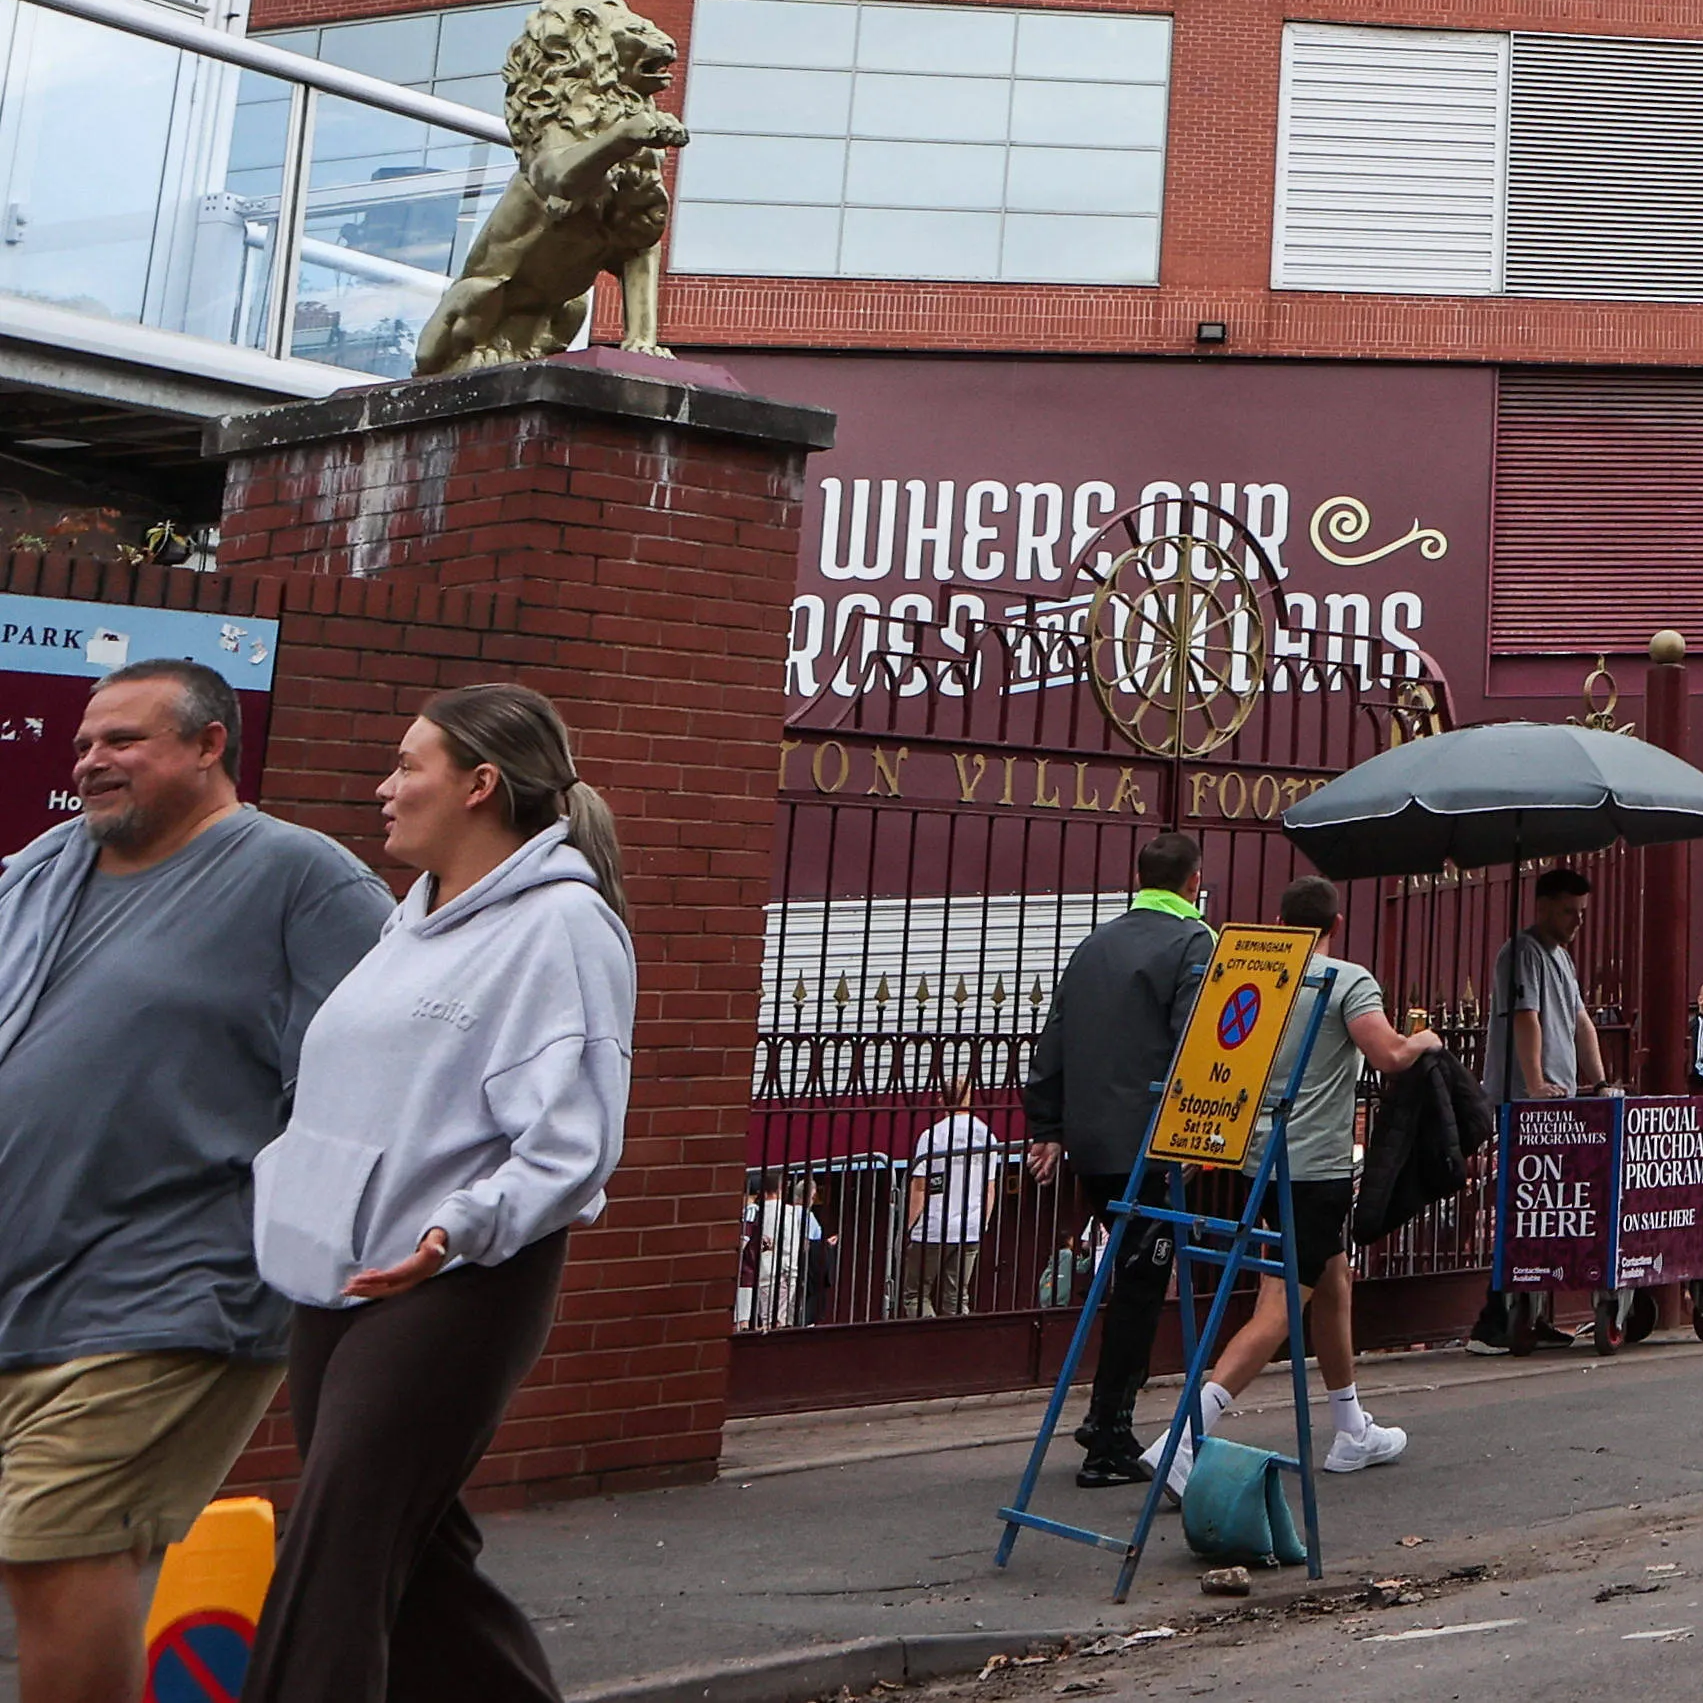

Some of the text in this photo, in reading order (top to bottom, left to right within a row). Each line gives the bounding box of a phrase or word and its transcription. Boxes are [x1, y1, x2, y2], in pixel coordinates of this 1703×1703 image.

[819, 477, 1290, 582] WHERE OUR
[1, 623, 84, 650] PARK
[784, 592, 986, 698] ROES
[778, 739, 1146, 816] TON VILLA
[1234, 939, 1293, 954] BIRMINGHAM
[1226, 958, 1286, 972] CITY COUNCIL
[1209, 1062, 1231, 1084] No
[1178, 1096, 1241, 1123] stopping
[1519, 1110, 1576, 1124] OFFICIAL
[1627, 1106, 1700, 1135] OFFICIAL
[1183, 1119, 1200, 1134] Sat
[1201, 1120, 1214, 1134] 12
[1519, 1121, 1587, 1135] MATCHDAY
[1169, 1133, 1188, 1148] Sun
[1189, 1134, 1201, 1149] 13
[1518, 1132, 1607, 1146] PROGRAMMES
[1517, 1154, 1564, 1183] ON
[1515, 1182, 1591, 1211] SALE
[1515, 1210, 1597, 1239] HERE
[1622, 1208, 1696, 1233] ON SALE HERE
[1512, 1266, 1551, 1276] Contactless
[1622, 1255, 1653, 1268] Contactless
[1512, 1274, 1542, 1283] Available
